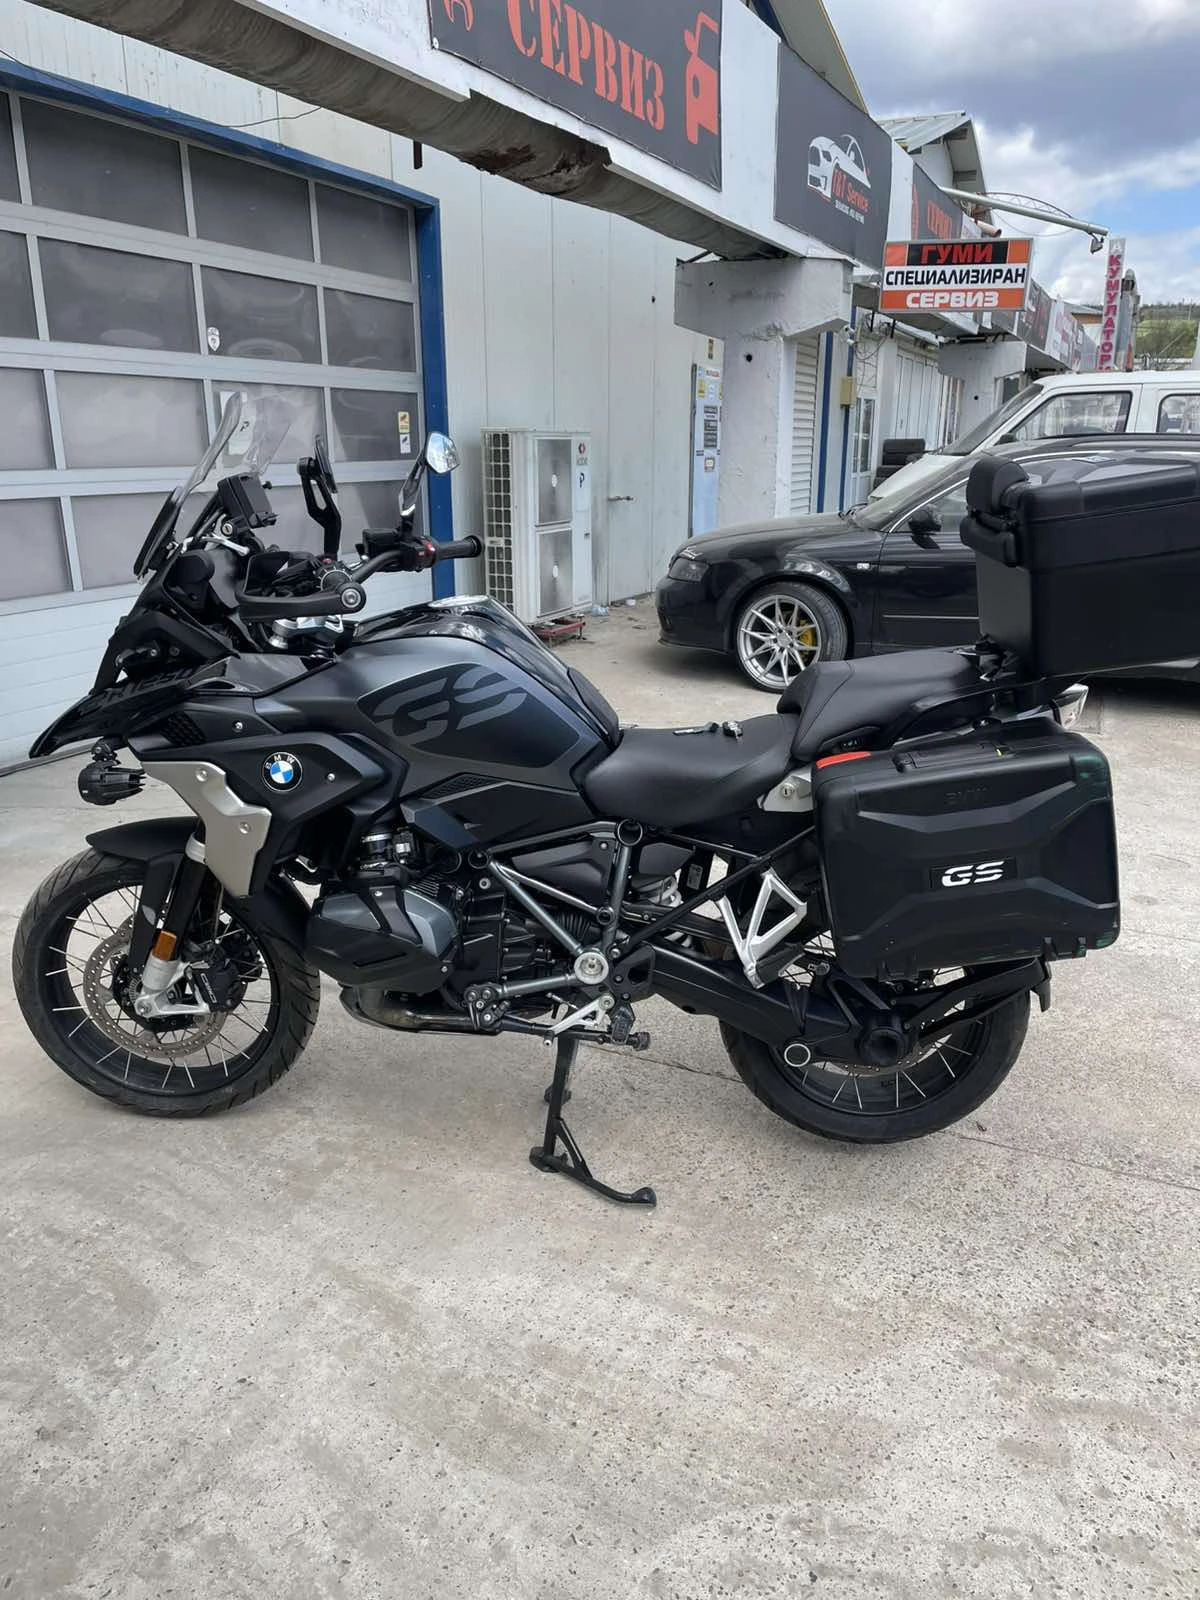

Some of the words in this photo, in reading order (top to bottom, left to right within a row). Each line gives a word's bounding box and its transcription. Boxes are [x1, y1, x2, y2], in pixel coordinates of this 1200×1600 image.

[507, 0, 665, 130] СЕРВИЗ
[920, 243, 993, 264] ГУМИ
[885, 267, 1026, 286] СПЕЦИАЛИЗИРАН
[906, 291, 999, 308] СЕРВИЗ
[373, 666, 528, 746] GS
[265, 753, 295, 770] BMW
[941, 861, 1005, 887] GS
